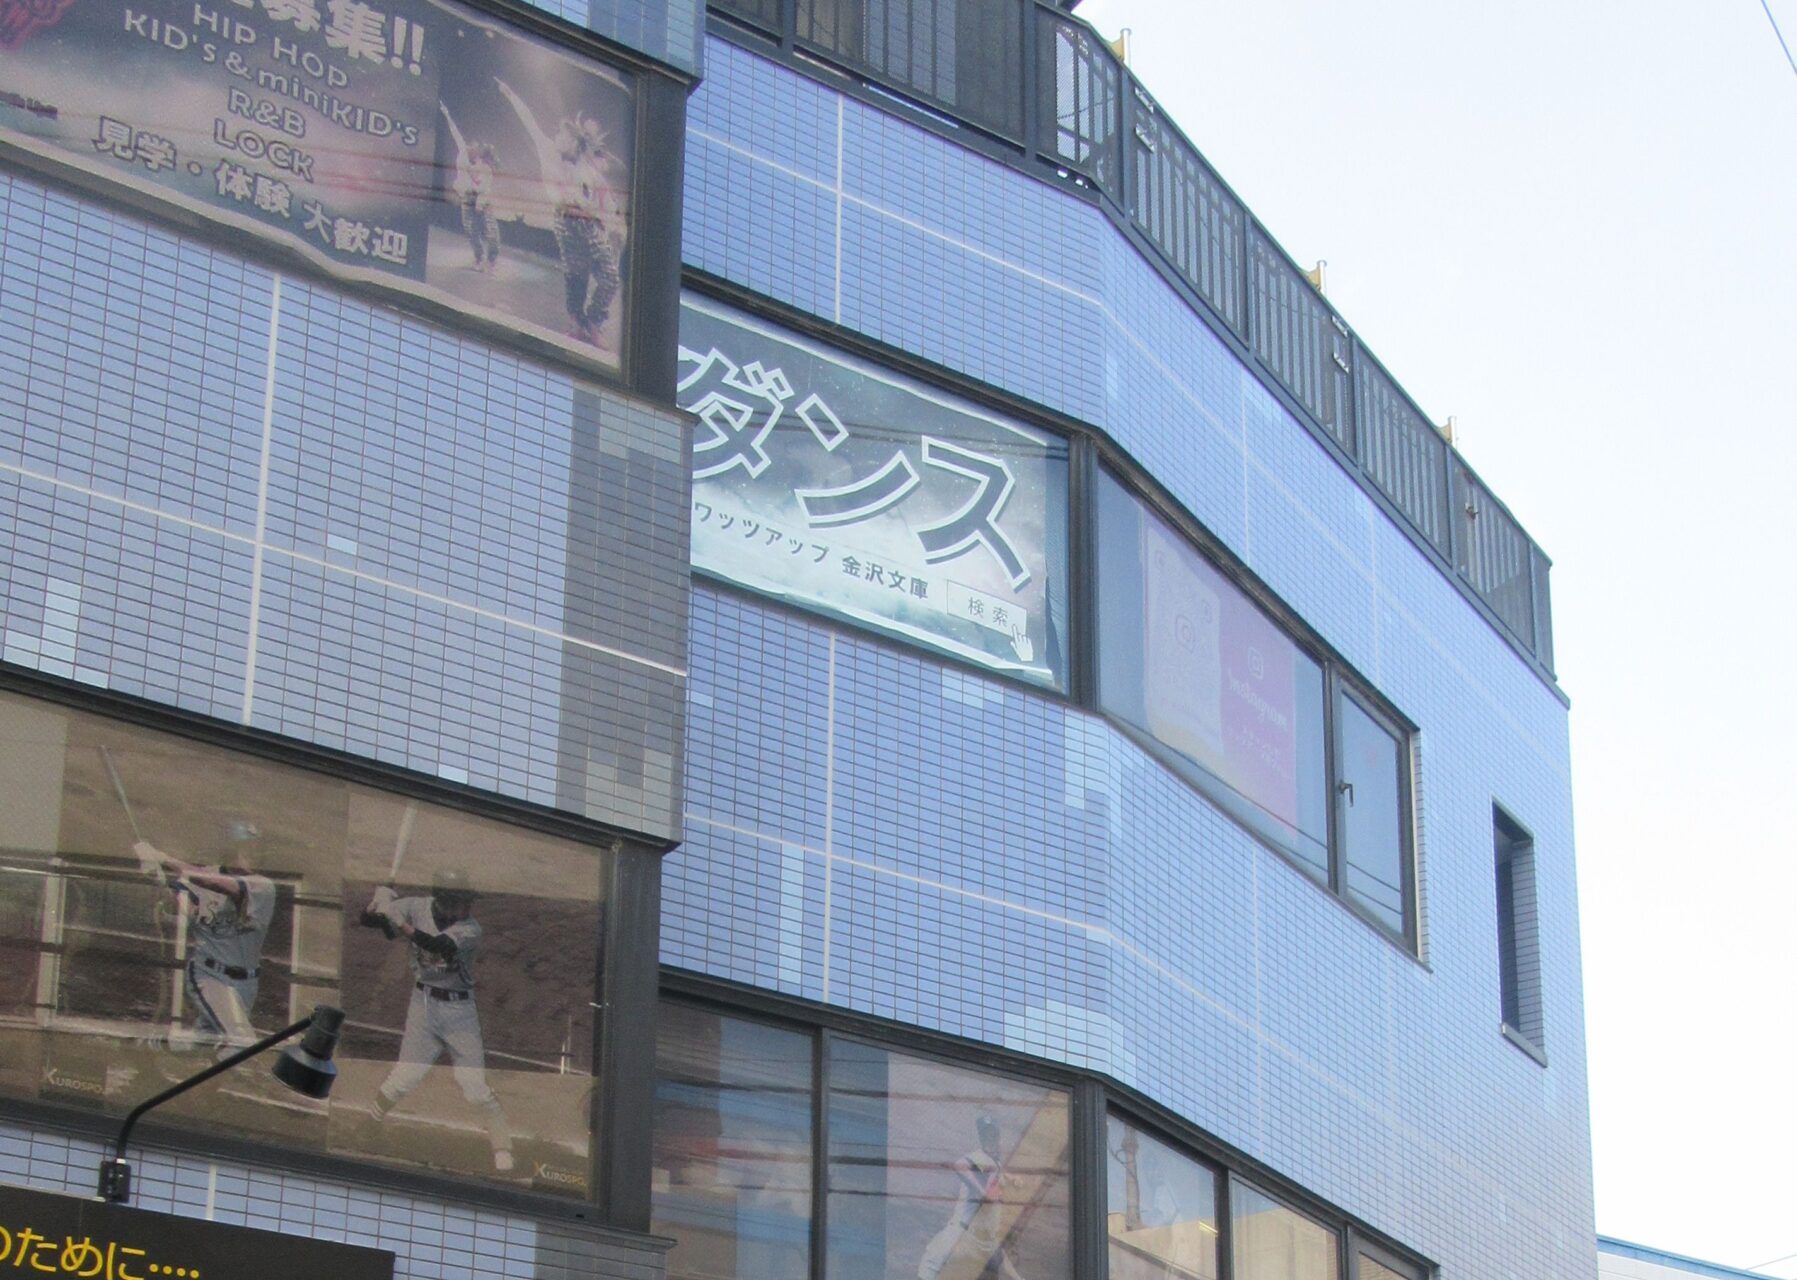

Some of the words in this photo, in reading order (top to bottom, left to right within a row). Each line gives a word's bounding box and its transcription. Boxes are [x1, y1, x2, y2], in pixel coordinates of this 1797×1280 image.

[193, 3, 257, 45] HIP
[272, 36, 349, 89] HOP
[227, 86, 306, 138] R&B
[213, 117, 314, 183] LOCK
[841, 555, 929, 600] 金沢文庫
[967, 596, 1009, 628] 検索
